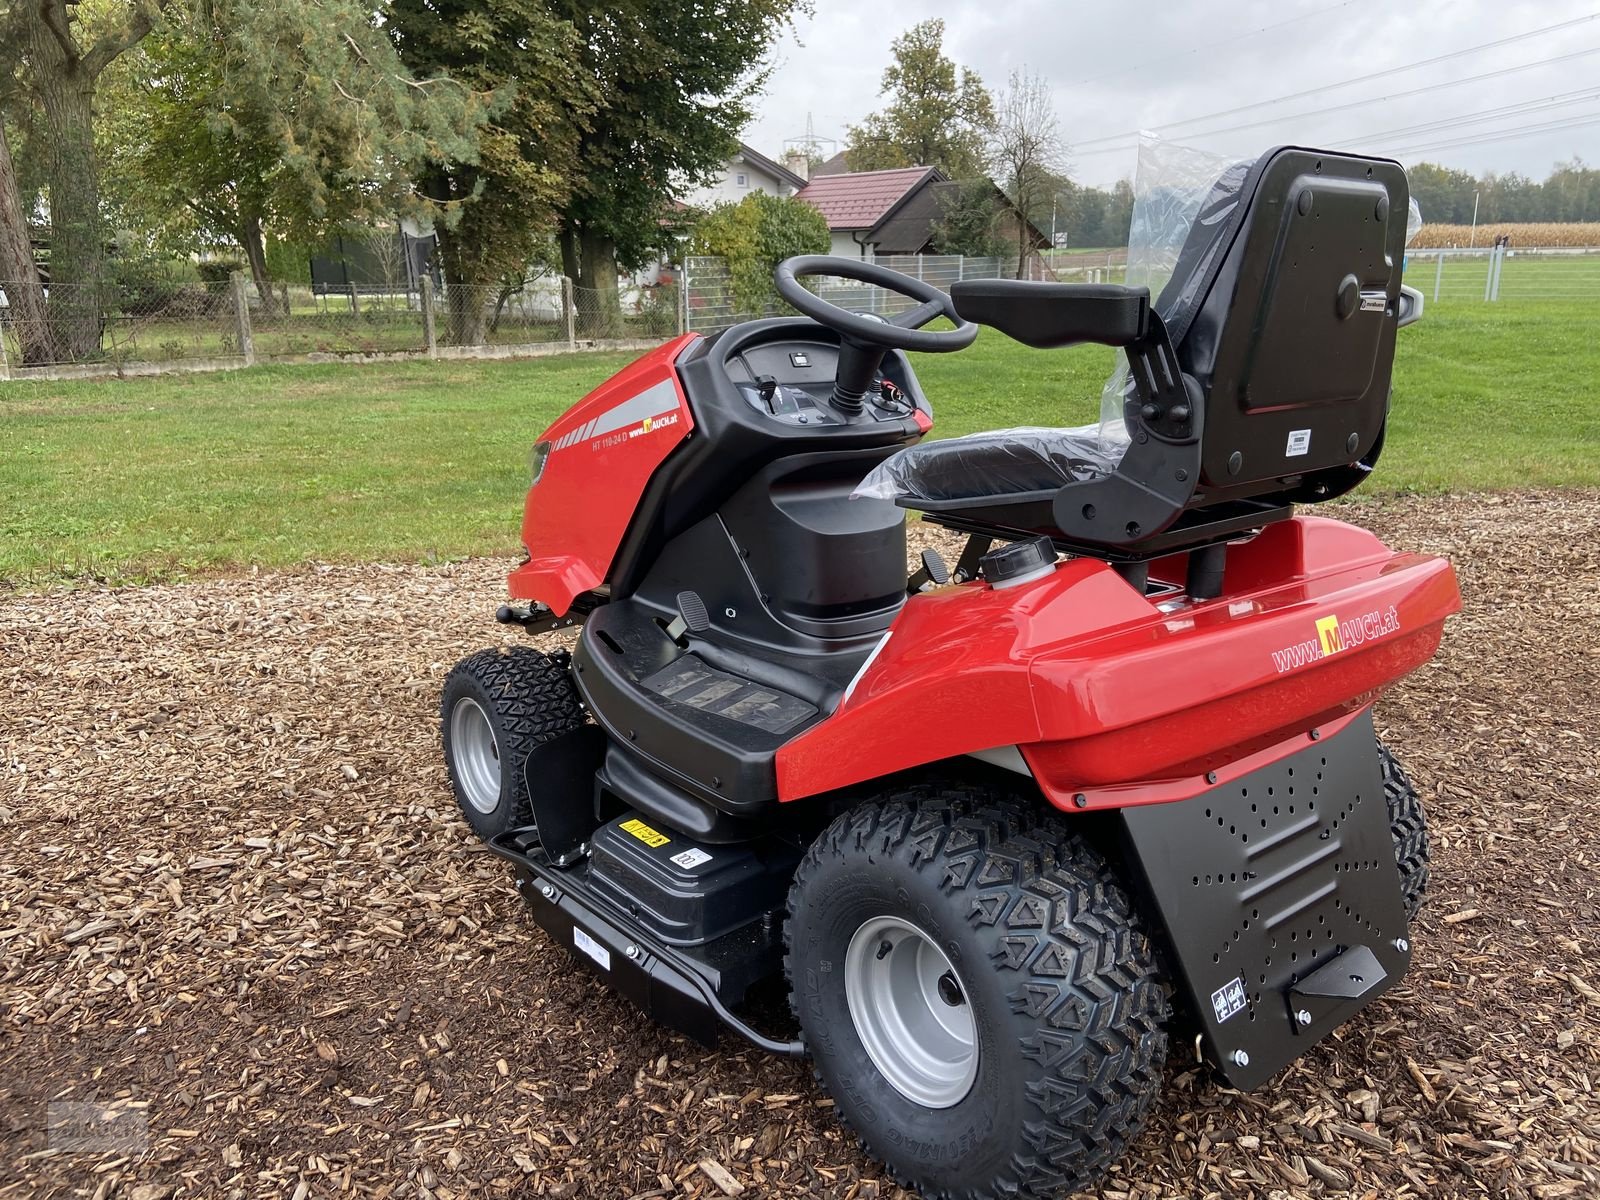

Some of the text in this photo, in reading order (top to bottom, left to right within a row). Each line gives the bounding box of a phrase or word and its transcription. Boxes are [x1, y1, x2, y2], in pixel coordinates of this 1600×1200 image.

[592, 440, 601, 452] HT
[622, 431, 628, 442] D
[1271, 605, 1401, 673] www.MAUCH.at
